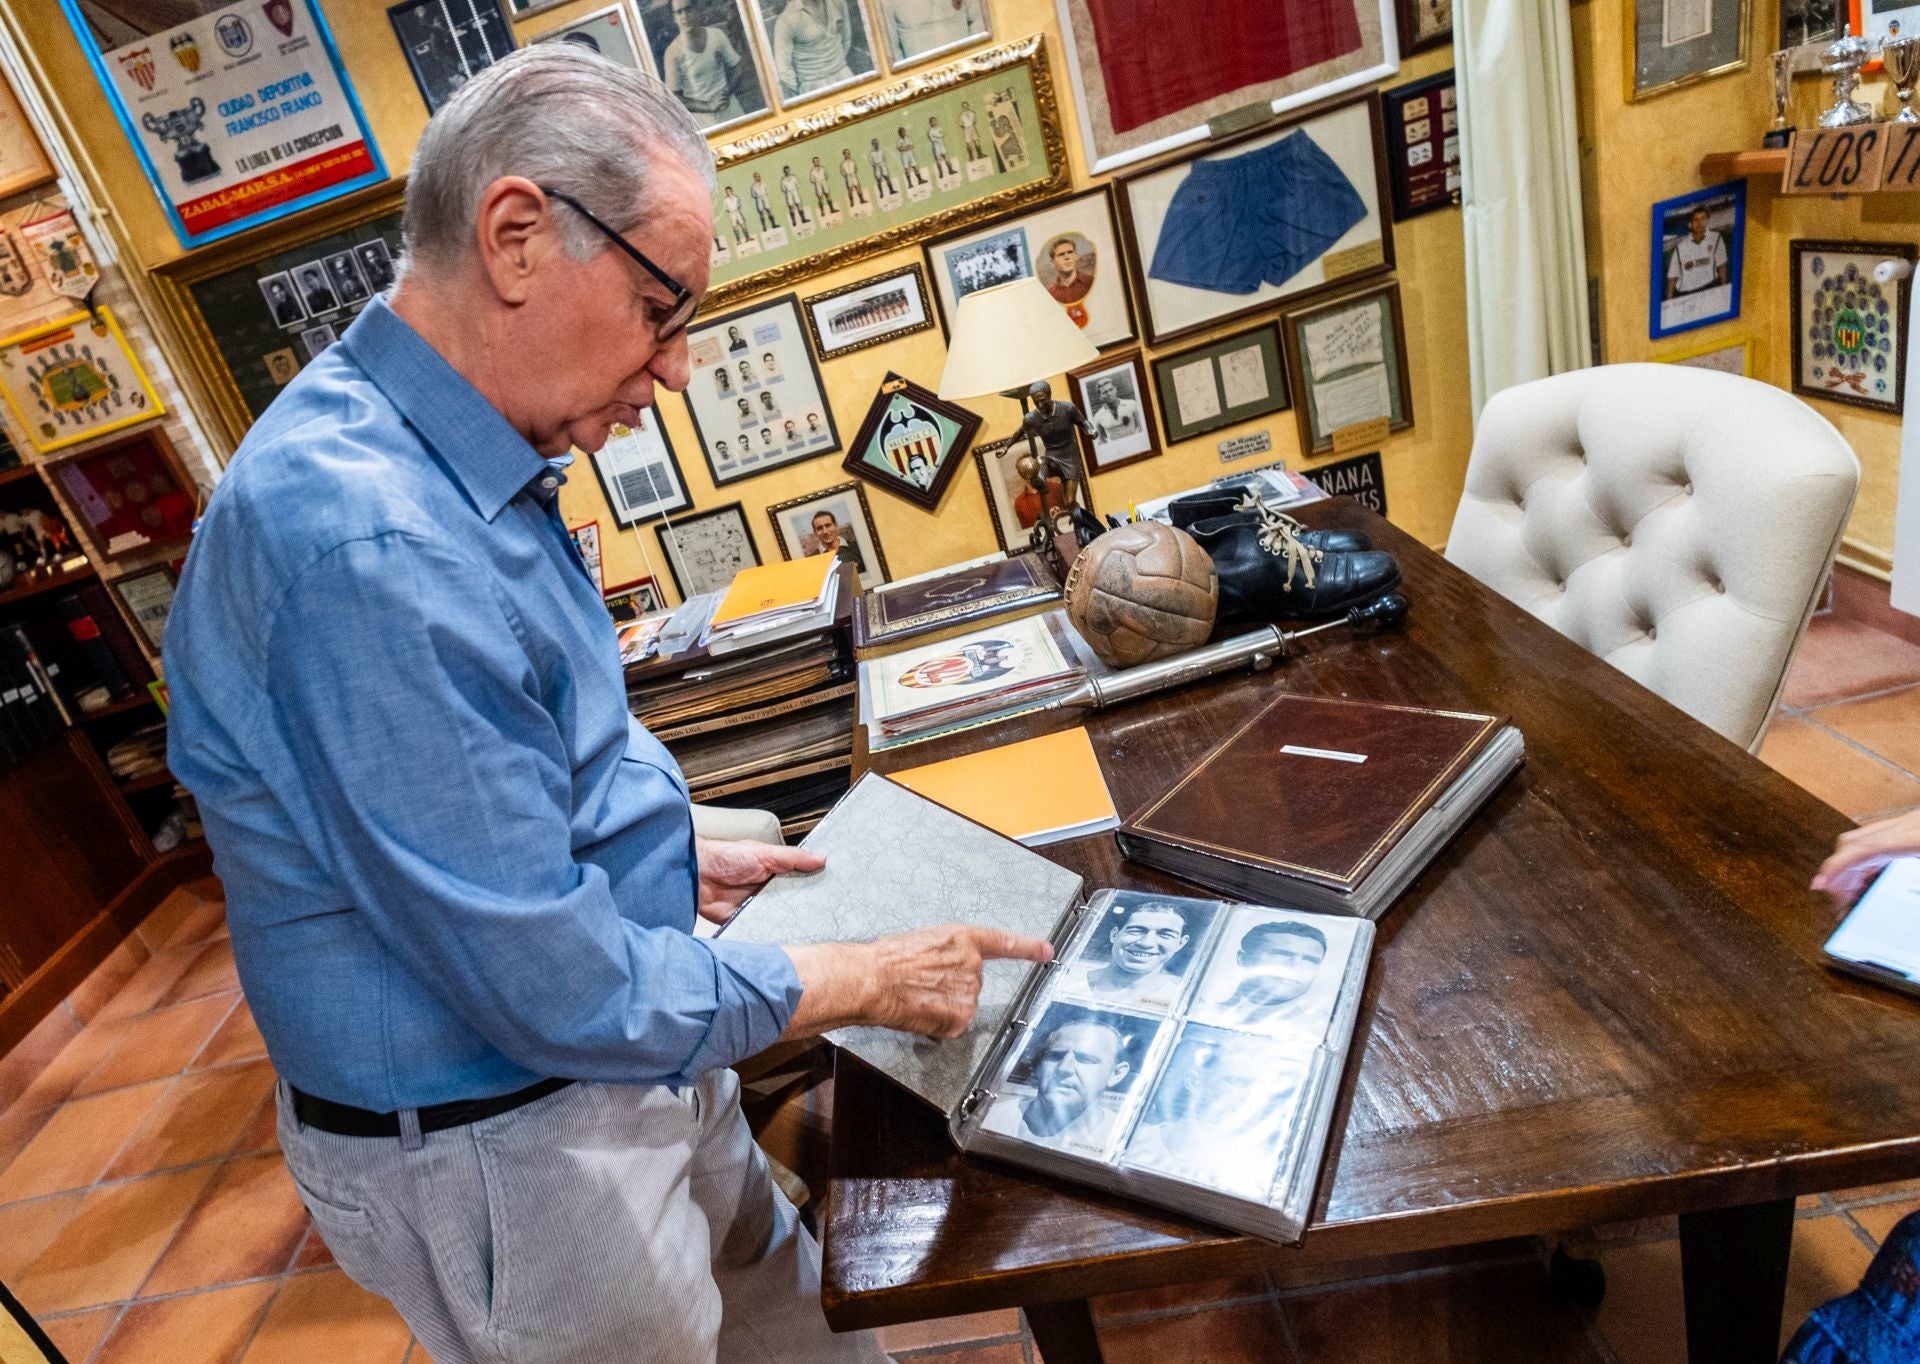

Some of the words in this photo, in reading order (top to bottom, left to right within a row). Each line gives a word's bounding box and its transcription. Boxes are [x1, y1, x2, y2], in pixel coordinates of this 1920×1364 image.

[218, 93, 255, 117] CIUDAD
[257, 71, 315, 103] DEPORTIVA
[225, 106, 281, 138] FRANCISCO
[279, 90, 323, 117] FRANCO
[1794, 129, 1878, 187] LOS
